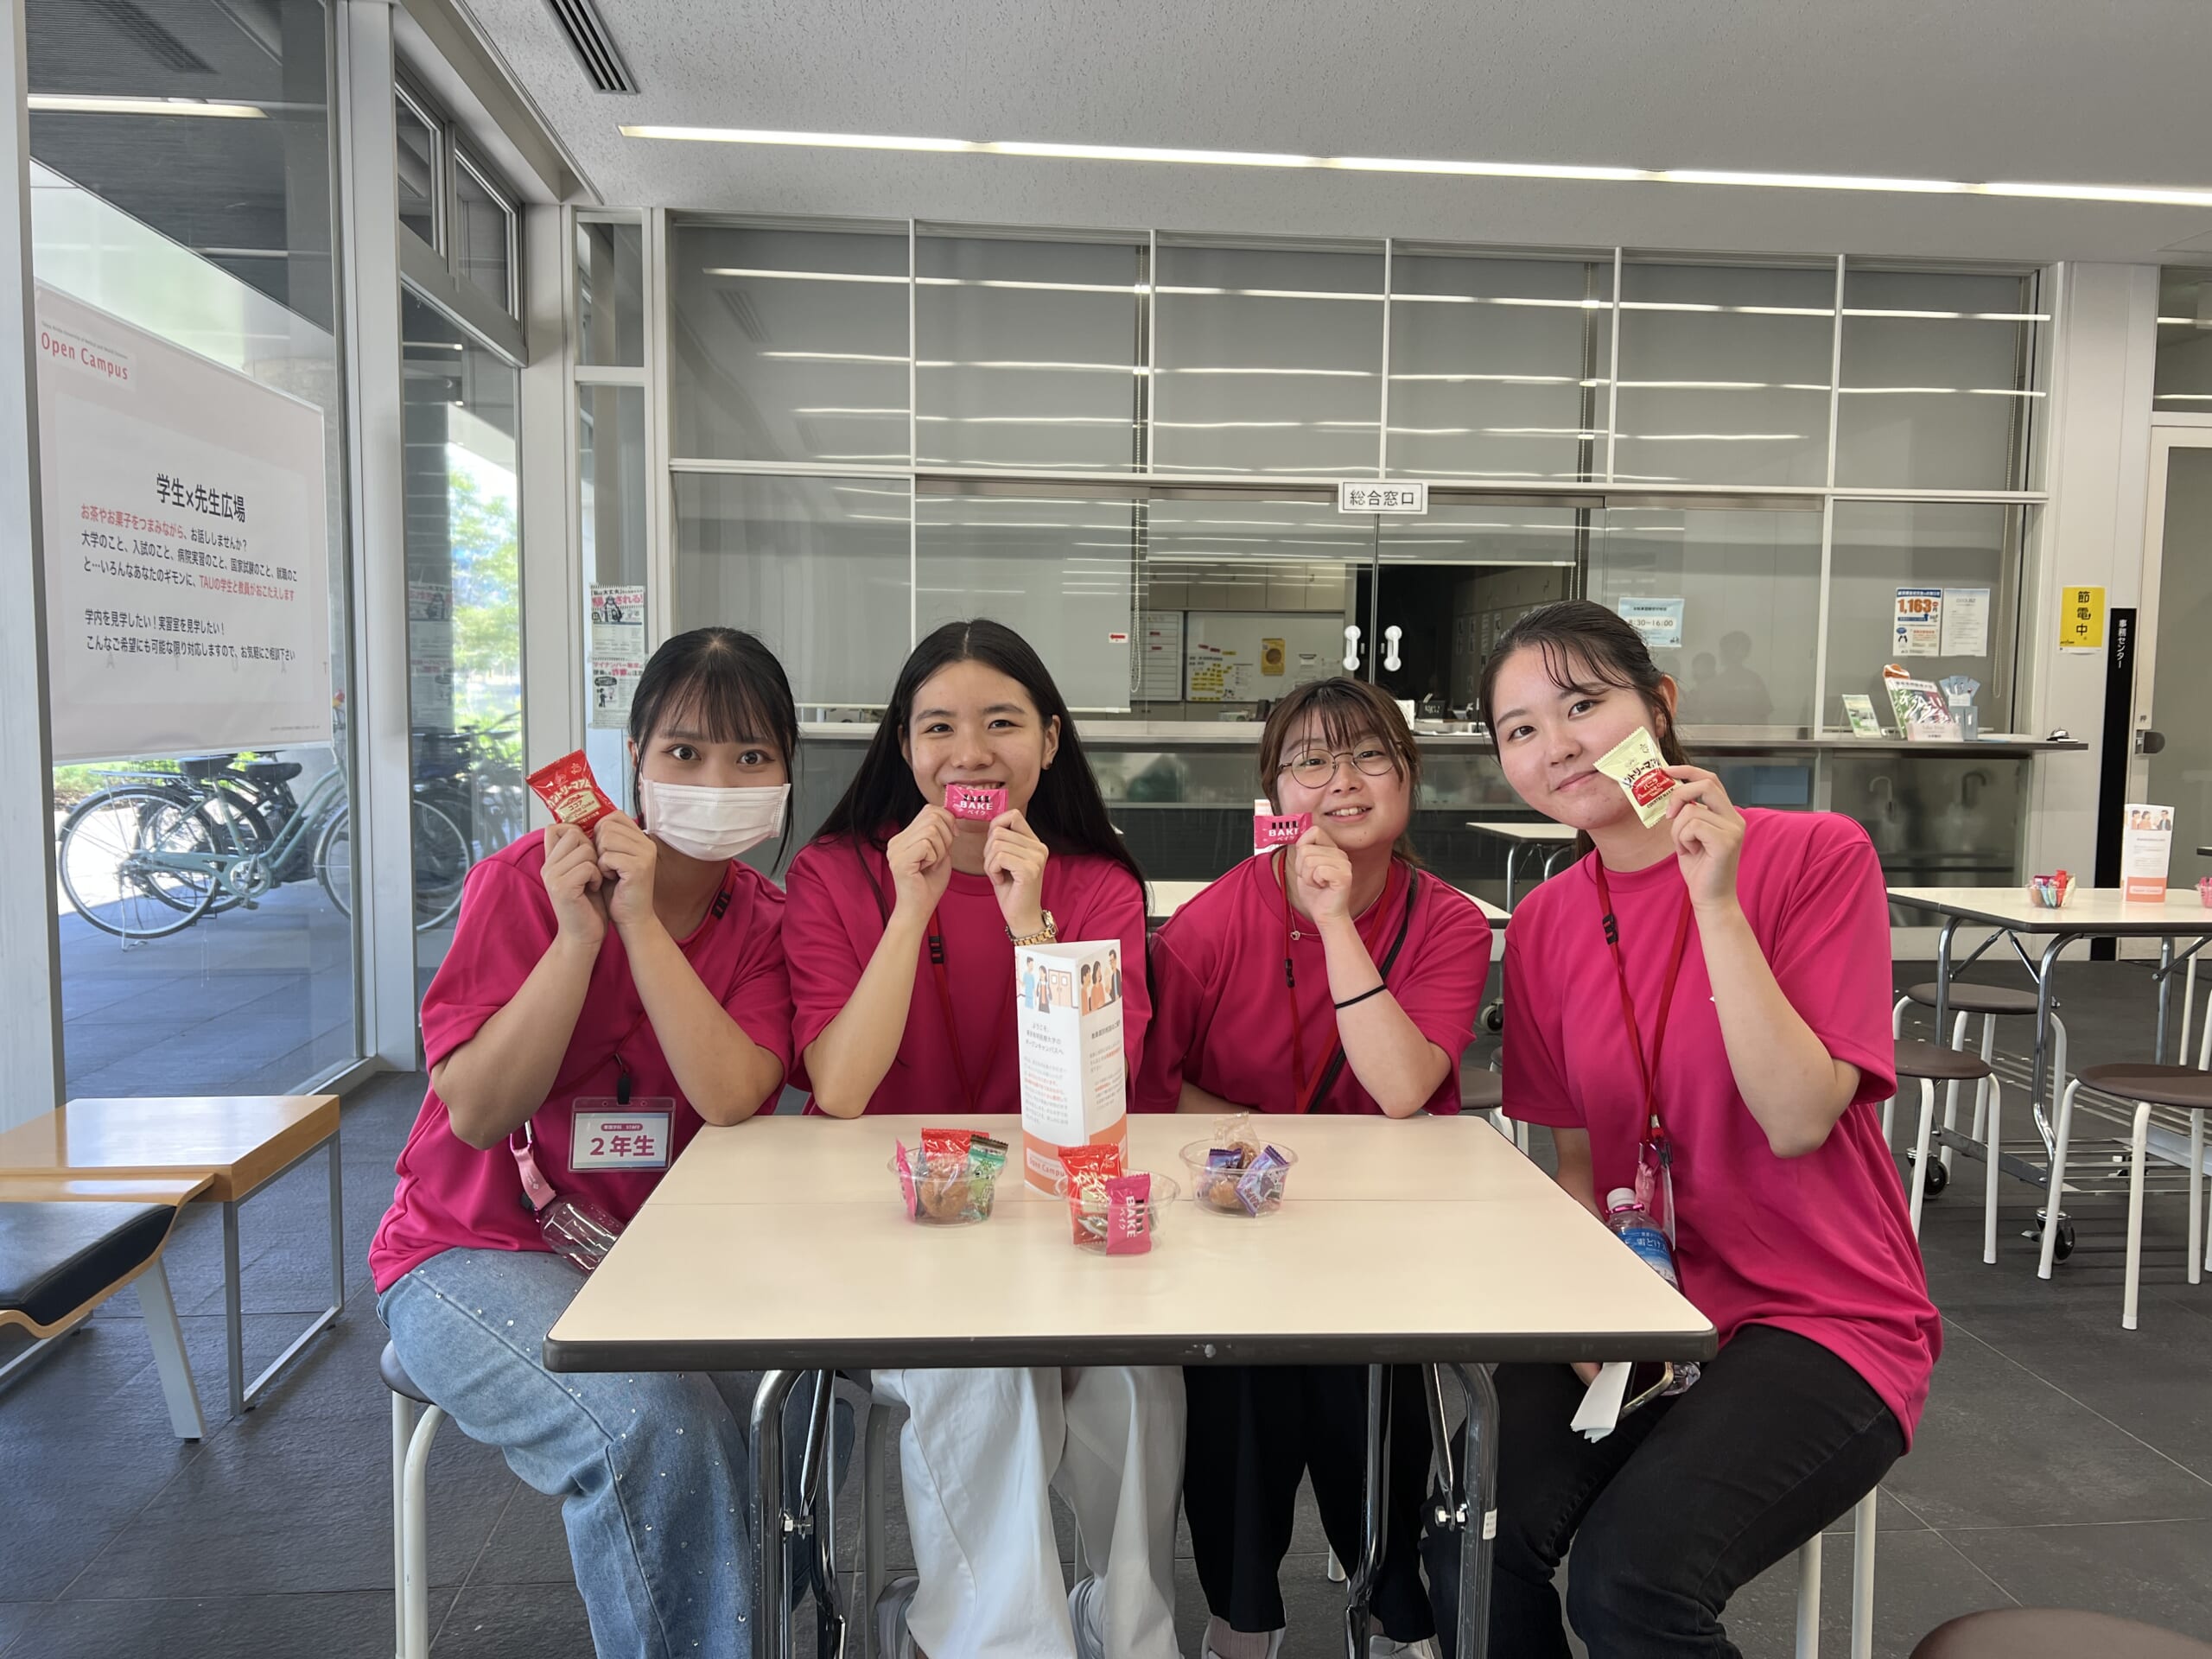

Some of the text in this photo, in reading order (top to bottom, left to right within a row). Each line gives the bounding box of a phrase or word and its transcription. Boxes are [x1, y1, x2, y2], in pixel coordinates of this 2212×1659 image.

[41, 332, 76, 359] Open
[80, 347, 128, 380] Campus
[1350, 490, 1414, 506] 総合窓口
[1897, 599, 1932, 614] 1,163
[960, 800, 994, 810] BAKE
[589, 1135, 655, 1157] 2年生
[1042, 1164, 1065, 1177] Campu
[1126, 1196, 1136, 1238] BAKE
